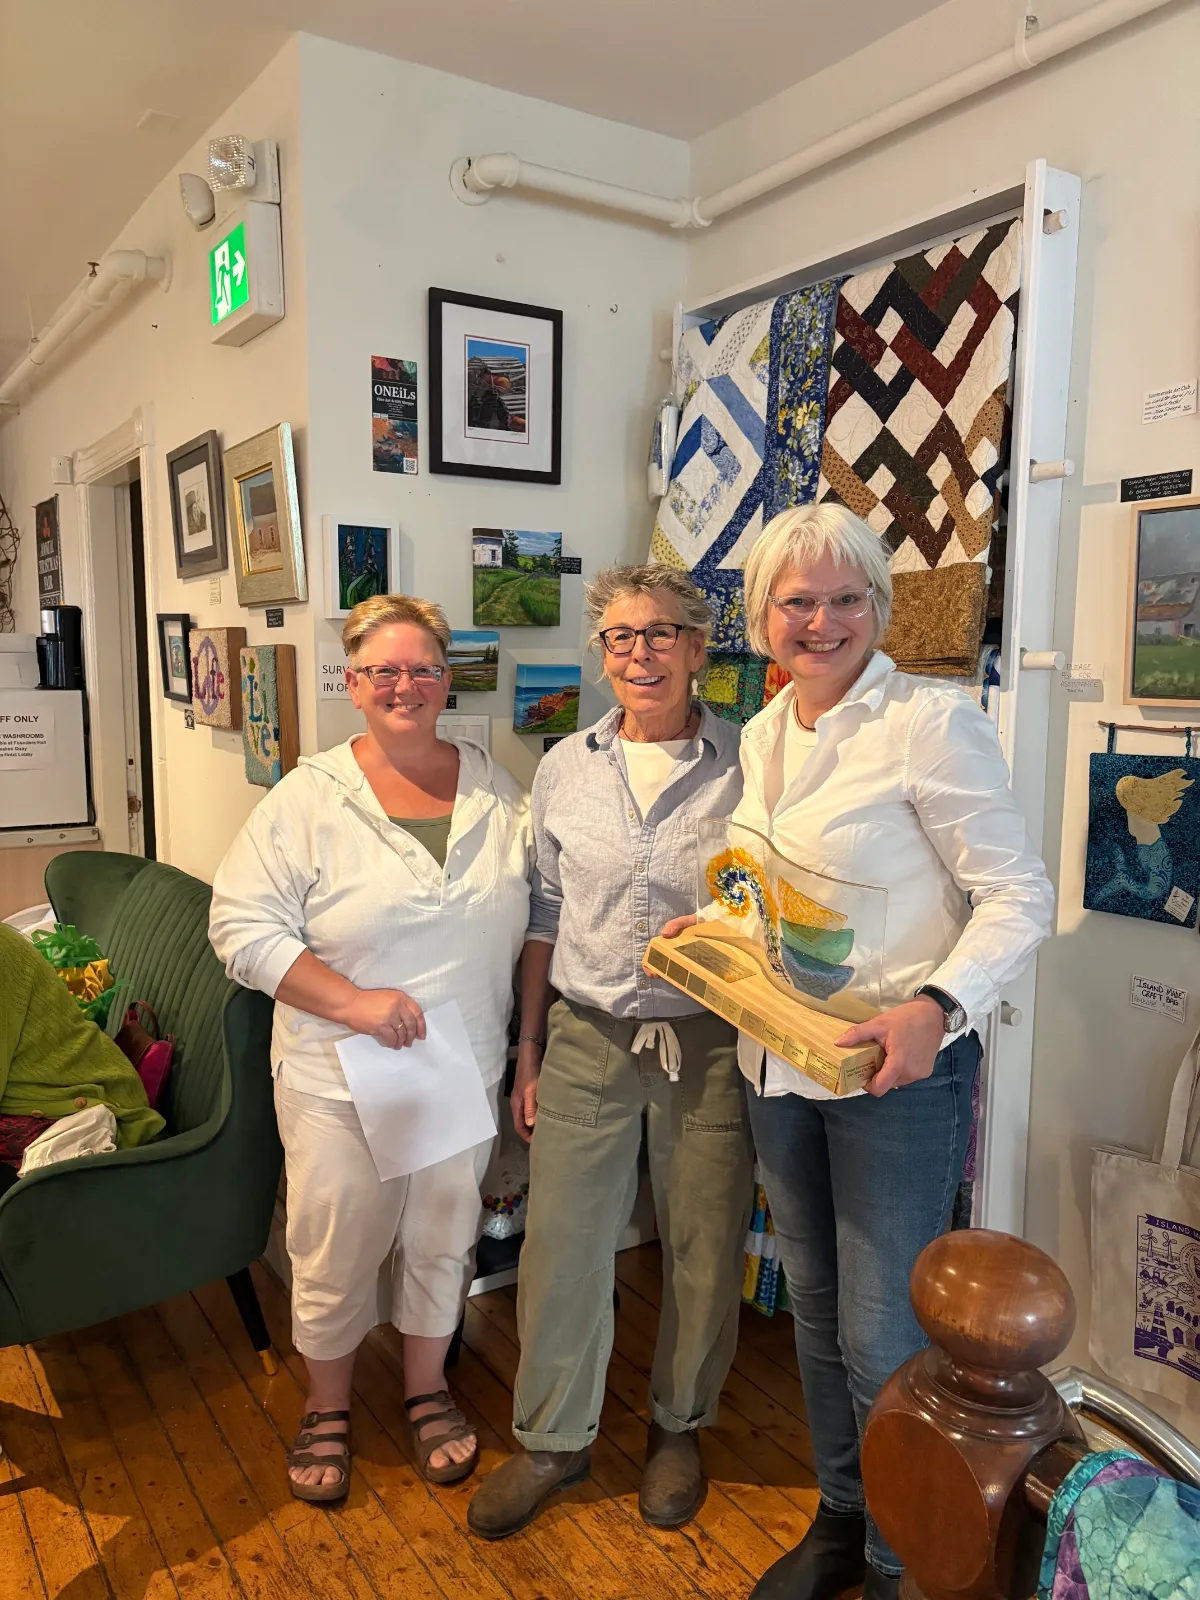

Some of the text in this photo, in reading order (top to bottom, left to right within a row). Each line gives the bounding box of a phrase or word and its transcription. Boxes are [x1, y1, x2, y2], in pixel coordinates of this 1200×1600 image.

[374, 384, 416, 400] ONEiLs
[323, 683, 333, 691] IN
[1060, 680, 1099, 688] ASSISTANCE
[14, 715, 39, 723] ONLY
[1141, 989, 1179, 1006] CRAFT BAG
[1156, 1220, 1190, 1234] ISLAND
